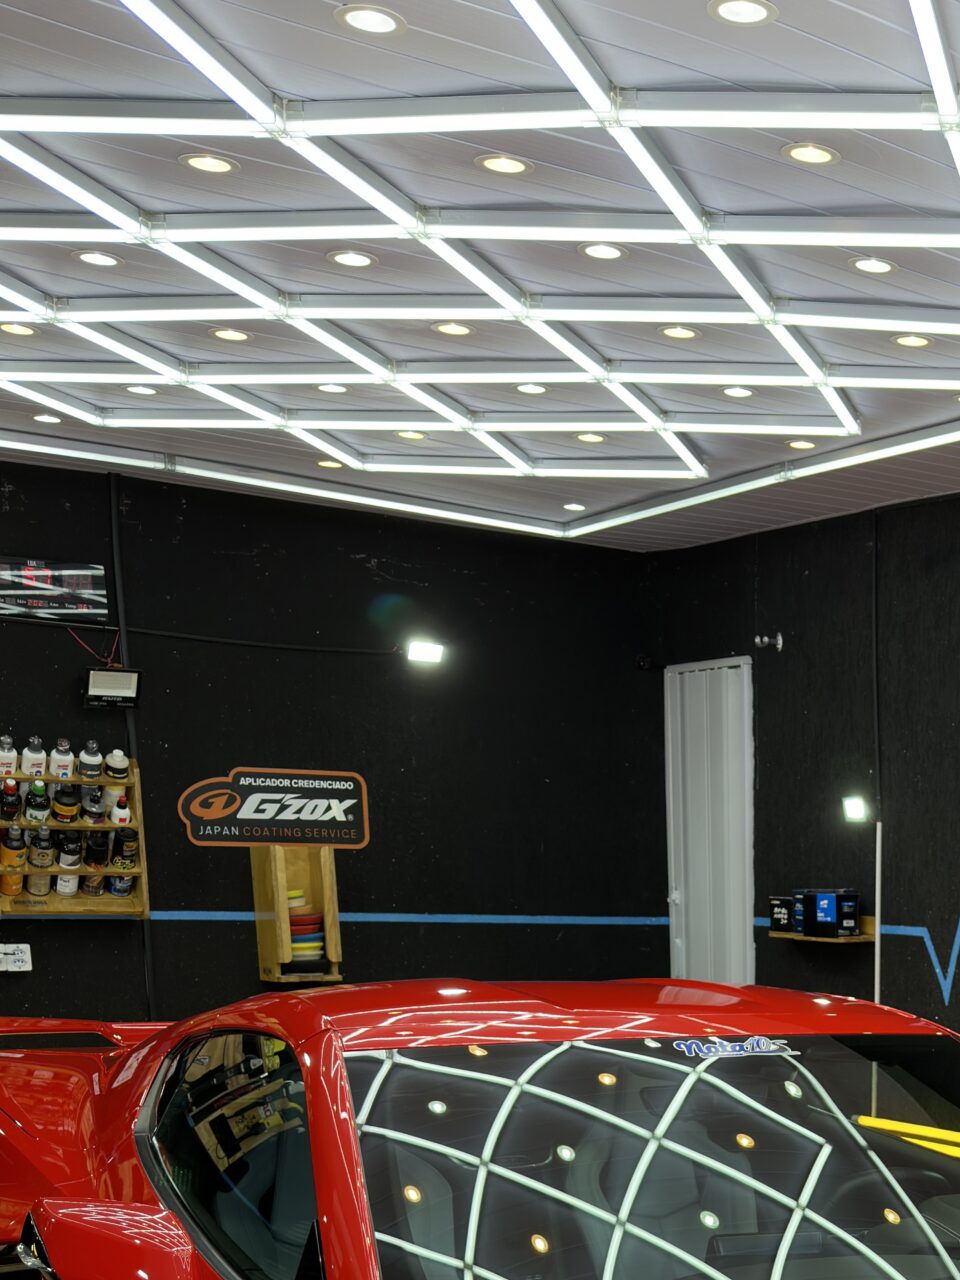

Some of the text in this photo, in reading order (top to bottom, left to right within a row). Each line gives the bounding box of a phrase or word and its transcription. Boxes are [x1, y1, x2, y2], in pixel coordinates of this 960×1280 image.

[239, 777, 354, 790] APLICADOR CREDENCIADO
[198, 825, 358, 839] JAPAN COATING SERVICE
